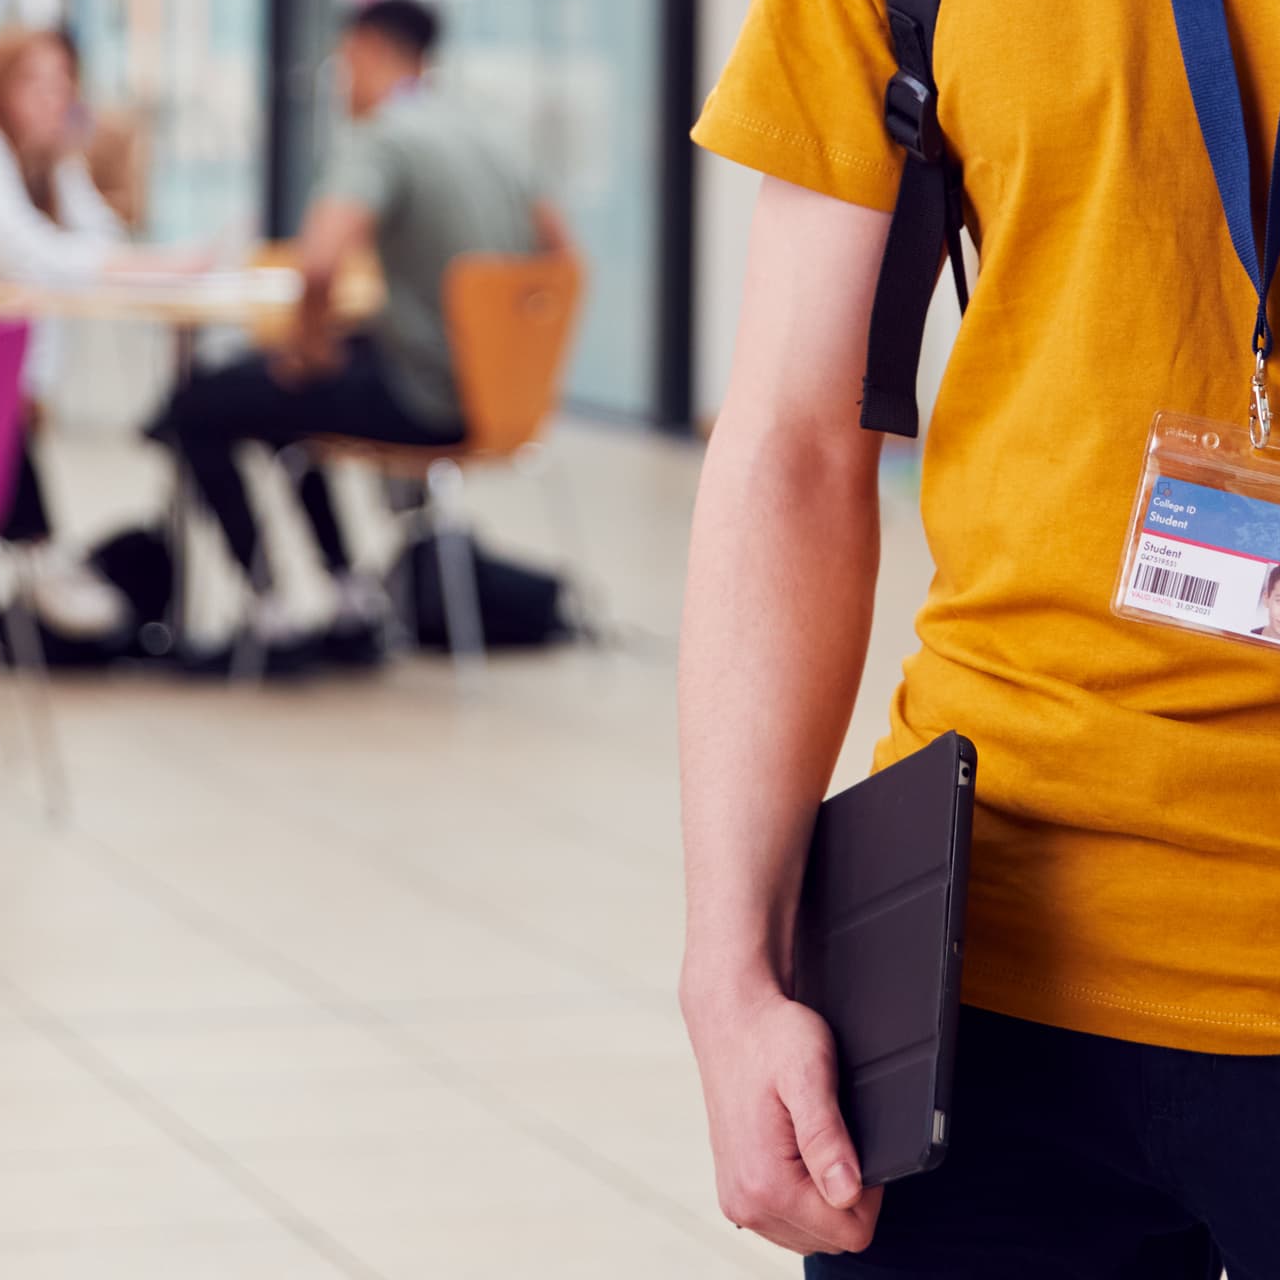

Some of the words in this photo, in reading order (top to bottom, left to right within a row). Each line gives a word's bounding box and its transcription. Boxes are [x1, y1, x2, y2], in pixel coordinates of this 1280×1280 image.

[1153, 497, 1185, 513] College
[1186, 505, 1197, 514] ID
[1149, 511, 1188, 529] Student
[1143, 541, 1182, 559] Student
